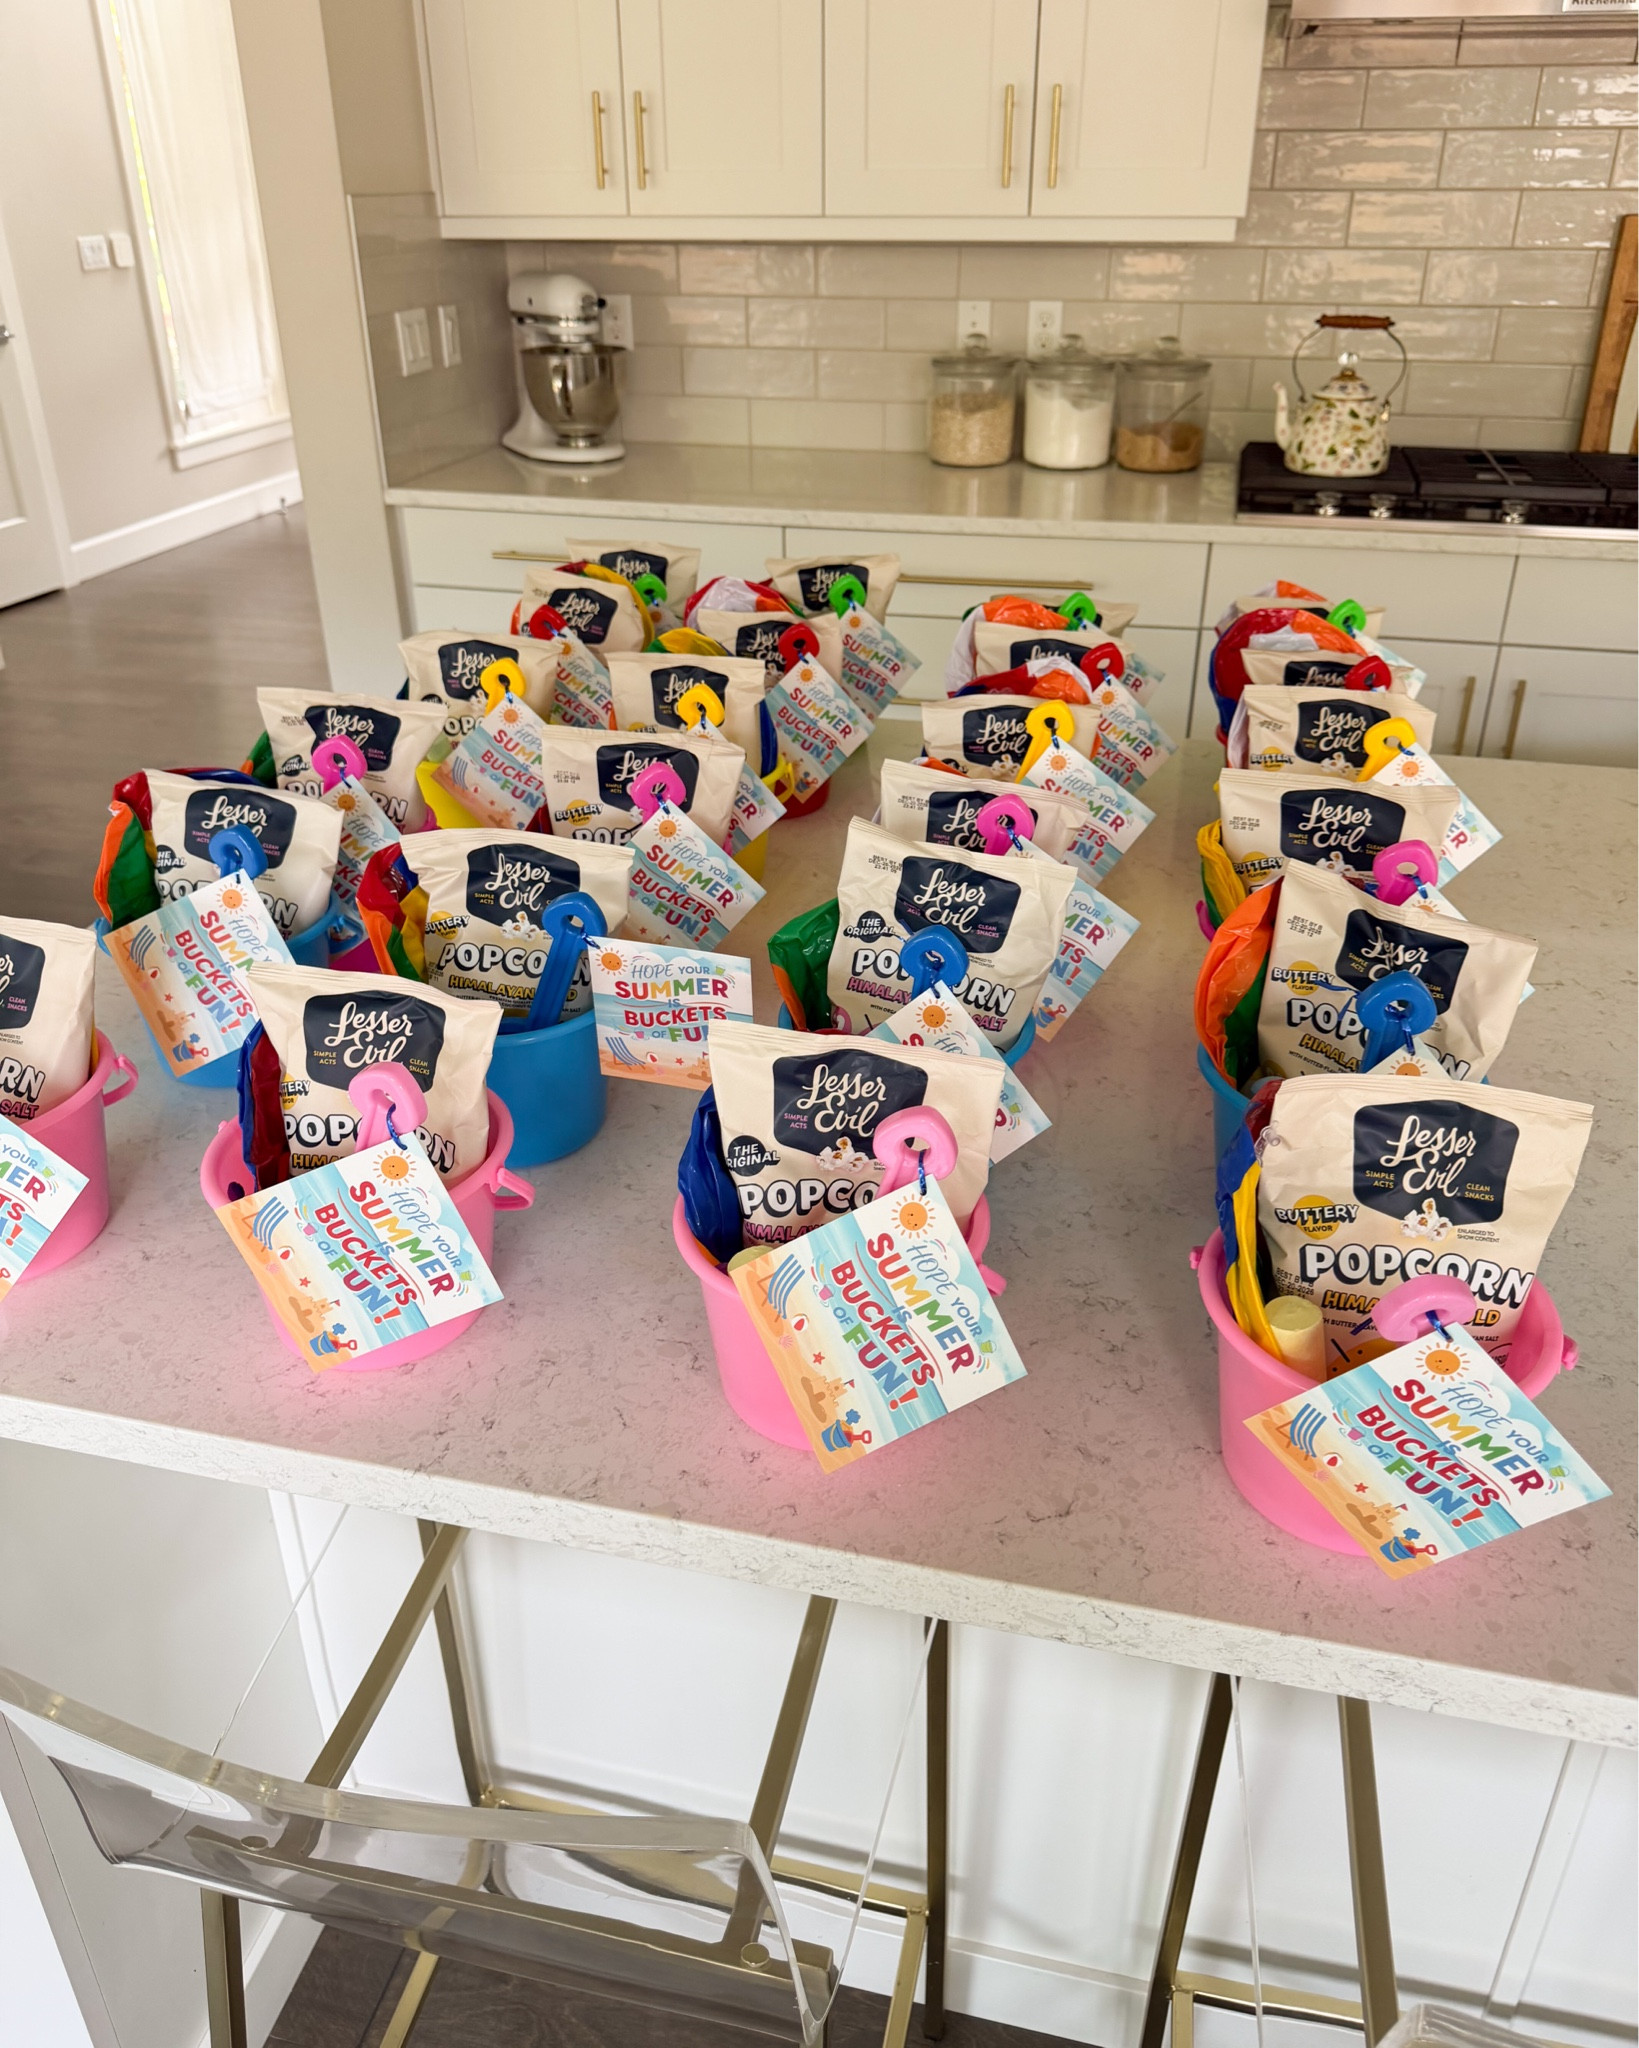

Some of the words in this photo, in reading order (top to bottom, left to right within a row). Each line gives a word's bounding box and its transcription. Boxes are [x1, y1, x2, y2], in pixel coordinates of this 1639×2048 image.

[842, 634, 901, 676] SUMMER
[556, 661, 614, 716] UMMER
[808, 687, 833, 707] HOPE
[846, 674, 885, 702] FUN!
[554, 689, 600, 726] CKETS
[790, 687, 852, 739] SUMMER
[1109, 708, 1134, 729] HOPE
[1311, 707, 1367, 737] Lesser
[325, 708, 375, 738] Lesser
[777, 706, 837, 751] BUCKETS
[976, 714, 1028, 744] Lesse
[1098, 714, 1153, 761] UMMER
[792, 733, 832, 765] FUN!
[987, 733, 1027, 755] Evil
[1319, 728, 1362, 754] Evil
[481, 750, 547, 798] BUCKET
[1096, 744, 1138, 774] CKETS
[500, 781, 544, 810] FUN
[1063, 773, 1097, 798] HOPE
[1099, 792, 1122, 810] YOUR
[201, 795, 268, 830] Lesser
[555, 803, 603, 822] BUTTERY
[1298, 797, 1373, 830] Lesser
[348, 819, 386, 848] HOPE
[1313, 820, 1364, 854] Evil
[485, 853, 551, 890] Lesser
[646, 844, 737, 909] SUMMER
[671, 841, 708, 869] HOPE
[708, 863, 733, 884] YOUR
[1232, 857, 1285, 875] BUTTERY
[474, 892, 495, 900] SIMPLE
[500, 877, 546, 911] Evil
[631, 868, 716, 924] BUCKETS
[676, 882, 689, 893] IS
[913, 868, 987, 907] Lesser
[641, 896, 656, 909] OF
[652, 903, 710, 943] FUN!
[861, 918, 882, 927] THE
[925, 893, 979, 934] Evil
[1073, 899, 1102, 919] YOUR
[229, 917, 264, 955] HOPE
[424, 915, 470, 935] BUTTERY
[847, 925, 897, 937] ORIGINAL
[976, 929, 1000, 939] SNACKS
[977, 923, 997, 932] CLEAN
[1361, 926, 1429, 964] Lesser
[175, 929, 254, 1018] BUCKETS
[221, 961, 235, 977] IS
[631, 963, 674, 979] HOPE
[677, 966, 710, 975] YOUR
[1271, 967, 1335, 985] BUTTERY
[9, 996, 26, 1004] CLEAN
[177, 961, 192, 977] OF
[185, 974, 242, 1035] FUN!
[448, 974, 536, 1000] HIMALAYAN
[615, 978, 729, 999] SUMMER
[847, 977, 912, 1005] HIMALAY
[7, 1003, 28, 1012] SNACKS
[624, 1006, 727, 1028] BUCKETS
[668, 998, 680, 1008] IS
[324, 1001, 413, 1046] Lesser
[651, 1030, 667, 1039] OF
[668, 1026, 709, 1042] FU
[313, 1050, 337, 1058] SIMPLE
[343, 1029, 408, 1068] Evil
[409, 1058, 428, 1067] CLEAN
[1299, 1034, 1359, 1071] HIMALA
[409, 1065, 430, 1075] SNACKS
[796, 1064, 887, 1110] Lesser
[0, 1099, 39, 1119] SALT
[783, 1113, 808, 1122] SIMPLE
[814, 1092, 880, 1138] Evil
[789, 1121, 808, 1129] ACTS
[733, 1143, 759, 1155] THE
[1380, 1115, 1477, 1167] Lesser
[2, 1144, 38, 1169] YOUR
[1365, 1170, 1395, 1180] SIMPLE
[1373, 1180, 1394, 1189] ACTS
[1402, 1148, 1466, 1197] Evil
[1466, 1182, 1491, 1192] CLEAN
[737, 1178, 881, 1218] POPCO
[1464, 1191, 1494, 1202] SNACKS
[389, 1191, 439, 1234] HOPE
[432, 1235, 462, 1268] YOUR
[1275, 1204, 1359, 1225] BUTTERY
[1303, 1225, 1333, 1233] FLAVOR
[318, 1240, 338, 1257] OF
[350, 1181, 455, 1297] SUMMER
[377, 1240, 395, 1257] IS
[315, 1202, 417, 1307] BUCKETS
[327, 1255, 402, 1324] FUN!
[866, 1233, 976, 1374] SUMMER
[906, 1243, 958, 1295] HOPE
[950, 1297, 983, 1337] YOUR
[831, 1260, 936, 1386] BUCKETS
[893, 1306, 912, 1324] IS
[832, 1307, 854, 1327] OF
[843, 1322, 920, 1411] FUN!
[1392, 1379, 1545, 1496] SUMMER
[1441, 1386, 1513, 1430] HOPE
[1506, 1430, 1550, 1464] YOUR
[1356, 1404, 1500, 1508] BUCKETS
[1438, 1440, 1461, 1457] IS
[1367, 1444, 1394, 1461] OF
[1384, 1457, 1484, 1529] FUN!
